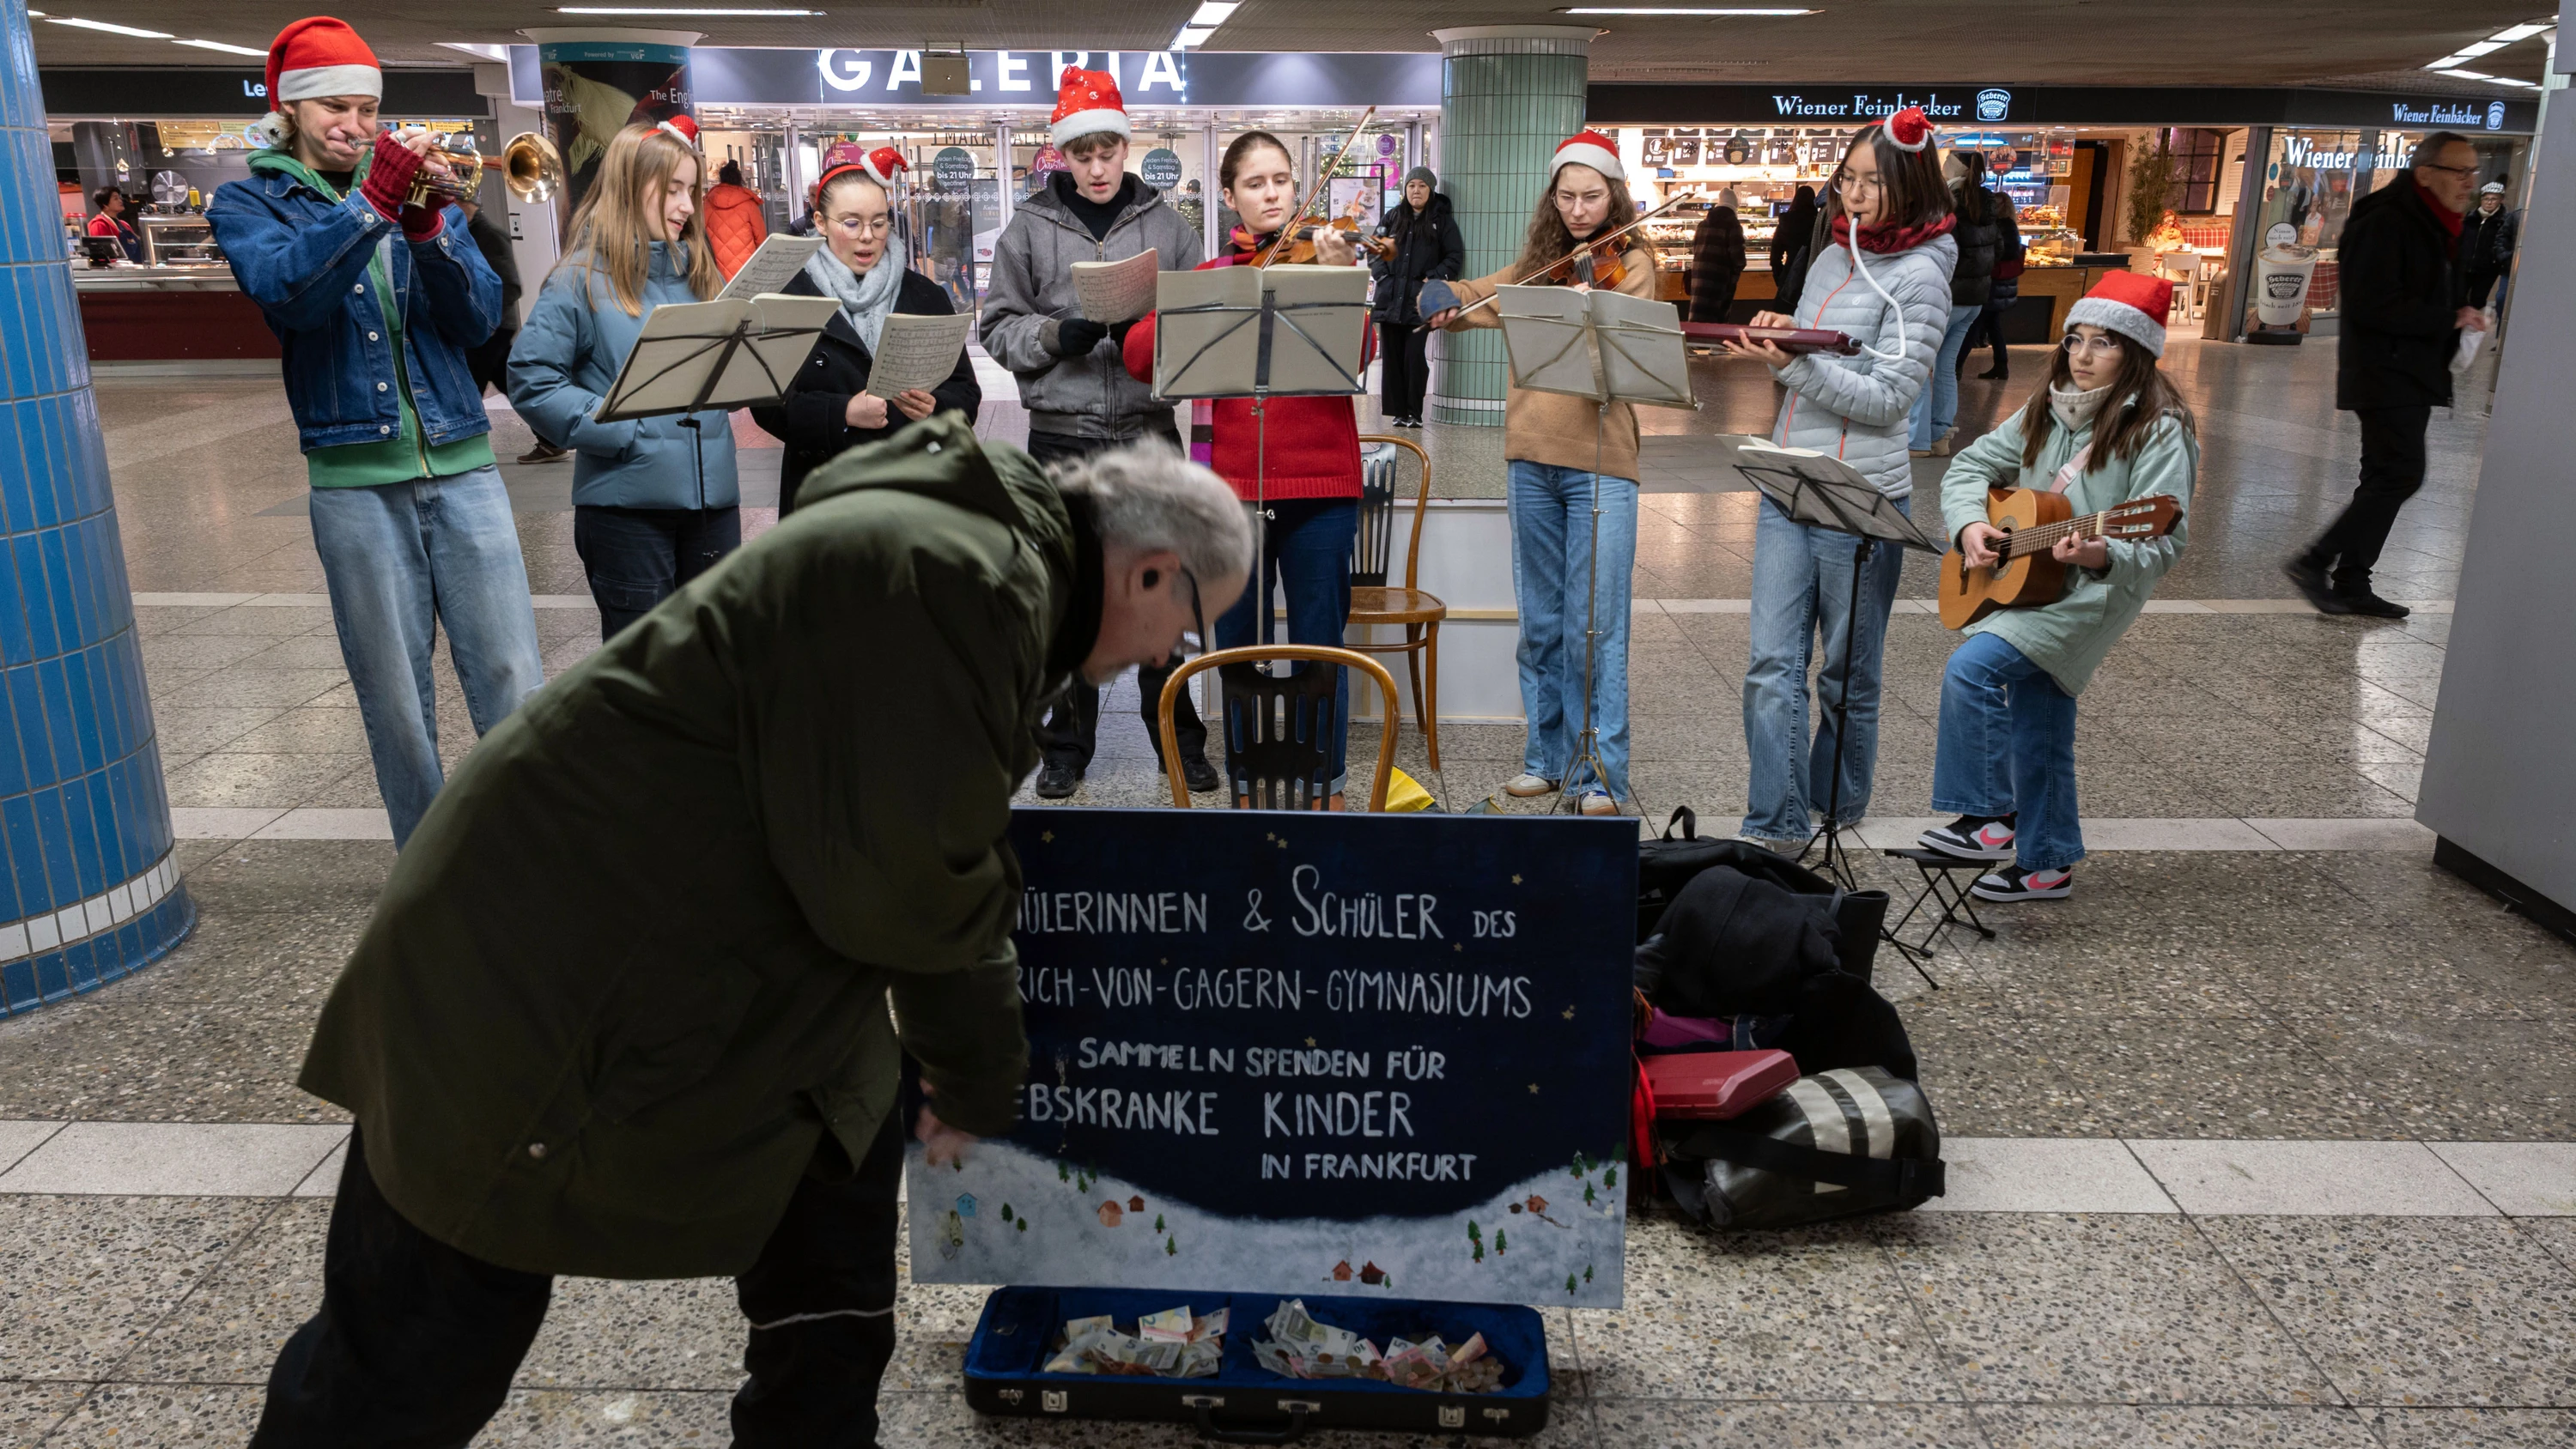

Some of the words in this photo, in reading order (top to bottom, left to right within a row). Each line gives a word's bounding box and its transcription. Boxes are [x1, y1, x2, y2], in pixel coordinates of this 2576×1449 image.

[244, 79, 269, 97] Le
[650, 90, 667, 100] The
[550, 103, 582, 113] Frankfurt
[1772, 95, 1848, 116] Wiener
[2392, 103, 2430, 123] Wiener
[2429, 103, 2482, 124] Feinbäcker
[936, 155, 952, 164] Jeden
[953, 155, 971, 164] Freitag
[2284, 136, 2354, 169] Wiener
[1242, 888, 1273, 932] &
[1473, 910, 1516, 938] DES
[1078, 1036, 1235, 1073] SAMMELN
[1245, 1046, 1370, 1078] SPENDEN
[1386, 1044, 1446, 1081] FÜR
[1264, 1090, 1415, 1137] KINDER
[1261, 1153, 1290, 1180] IN
[1304, 1152, 1478, 1181] FRANKFURT
